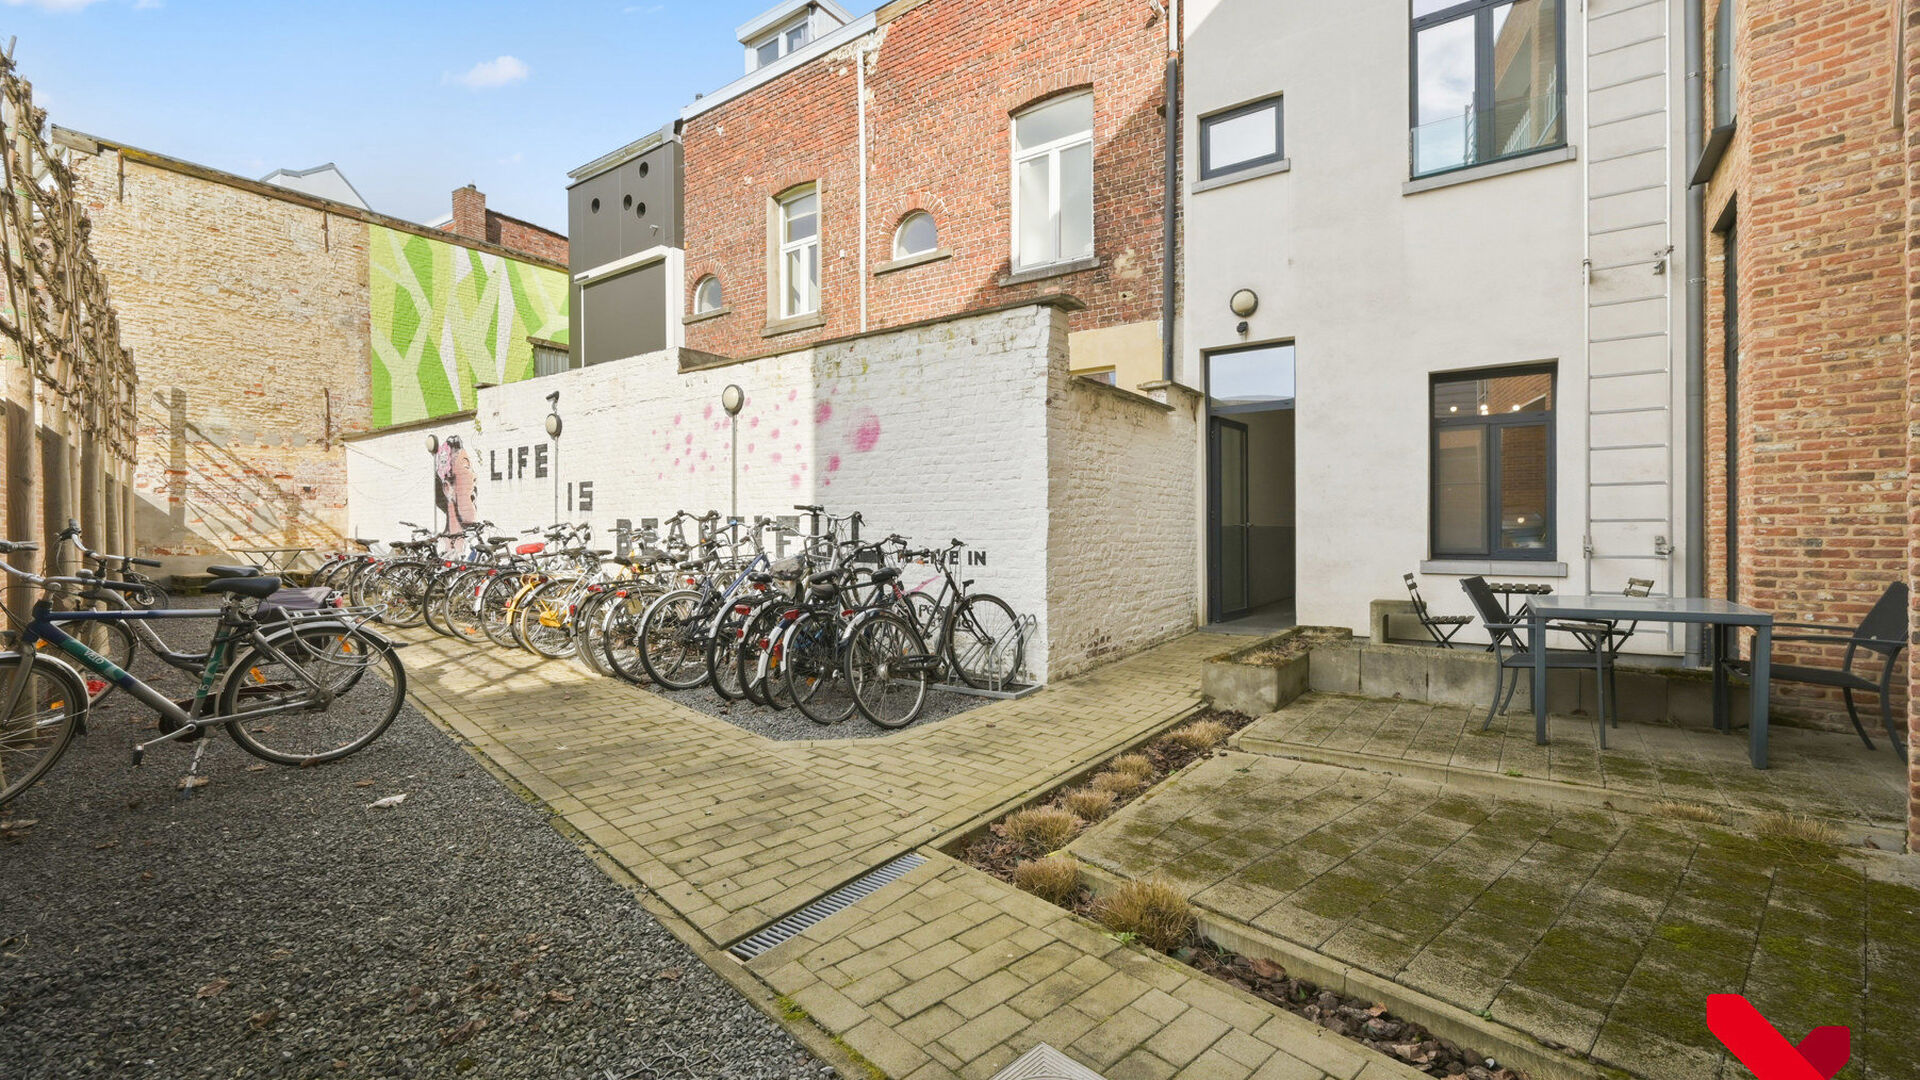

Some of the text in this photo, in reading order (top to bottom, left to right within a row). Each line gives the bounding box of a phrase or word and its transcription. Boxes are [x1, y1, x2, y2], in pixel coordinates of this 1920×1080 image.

[490, 443, 548, 481] LIFE
[567, 481, 593, 512] IS
[968, 550, 987, 566] IN
